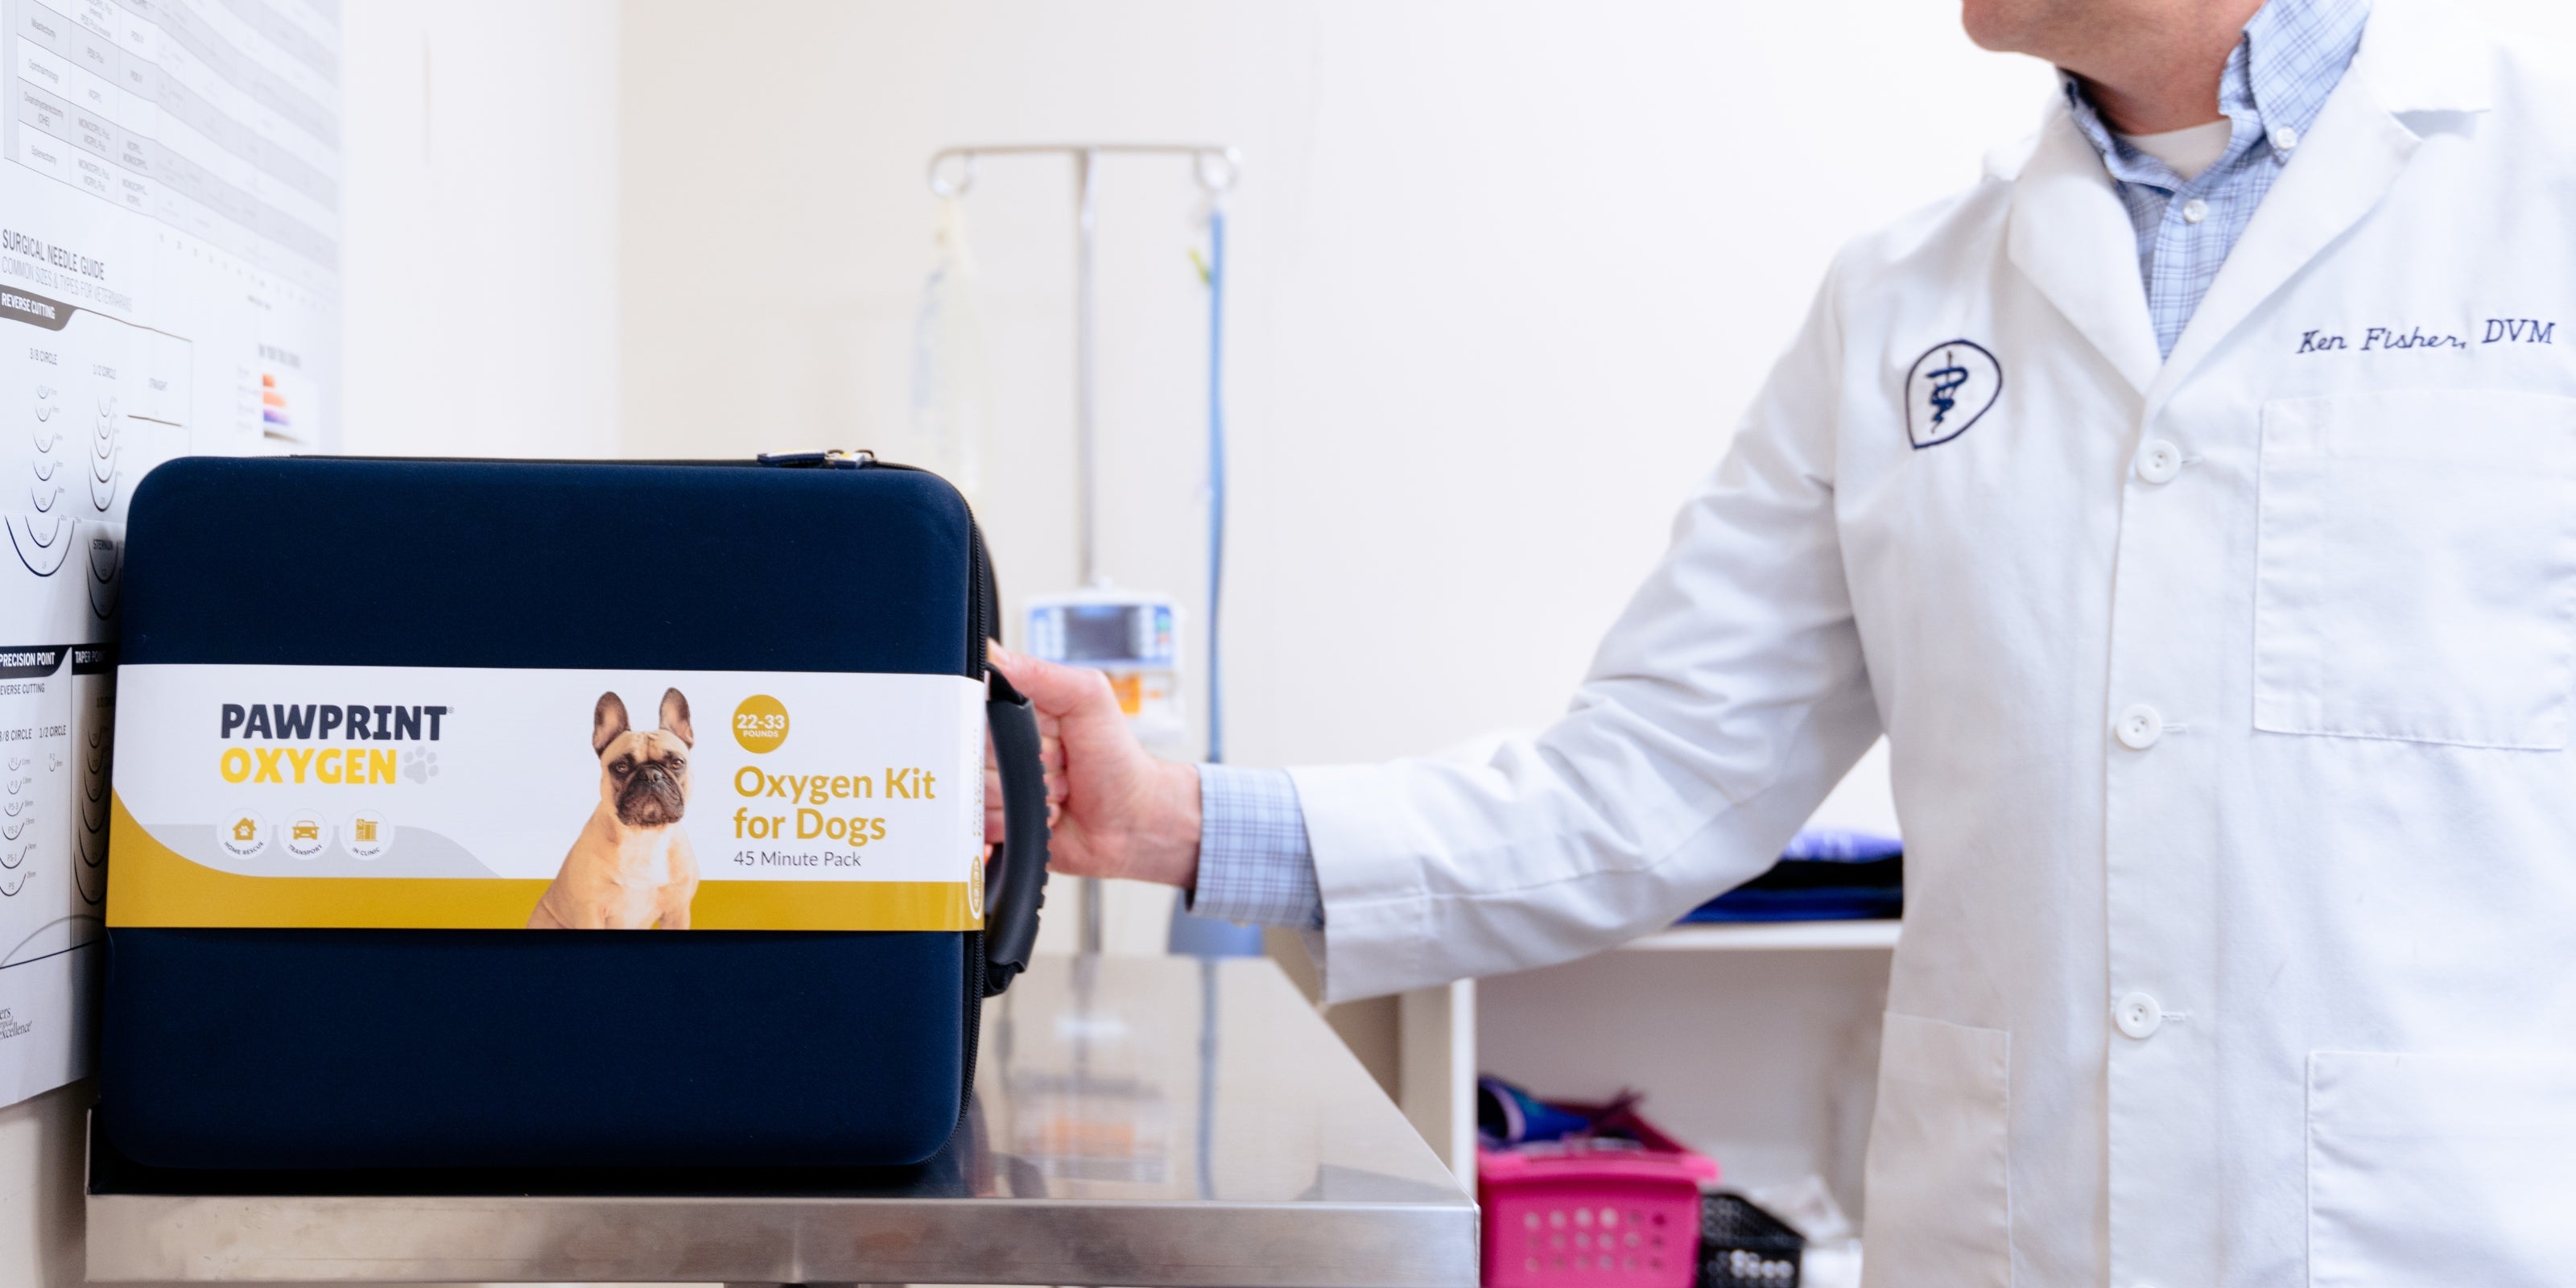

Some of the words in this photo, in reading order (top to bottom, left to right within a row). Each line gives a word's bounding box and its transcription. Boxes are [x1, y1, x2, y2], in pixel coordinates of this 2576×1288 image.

[2, 228, 45, 262] SURGICAL
[47, 244, 78, 273] NEEDLE
[80, 255, 105, 282] GUIDE
[2, 256, 35, 282] COMMON
[35, 266, 52, 287] SIZES
[60, 275, 79, 295] TYPES
[80, 280, 93, 299] FOR
[2, 292, 31, 312] REVERSE
[31, 300, 56, 320] CUTTING
[2296, 330, 2347, 354] Ken
[2360, 326, 2467, 351] Fisher,
[2481, 319, 2556, 345] DVM
[30, 347, 39, 361] 3/8
[39, 350, 58, 365] CIRCLE
[102, 365, 117, 380] CIRCLE
[0, 652, 35, 667] PRECISION
[37, 651, 56, 666] POINT
[75, 650, 91, 663] TAPER
[23, 683, 45, 694] CUTTING
[737, 714, 786, 729] 22-33
[10, 729, 32, 741] CIRCLE
[39, 727, 49, 738] 1/2
[50, 725, 66, 737] CIRCLE
[743, 730, 779, 738] POUNDS
[220, 747, 397, 784] OXYGEN
[733, 766, 873, 805] Oxygen
[885, 767, 936, 799] Kit
[733, 807, 786, 840] for
[796, 808, 886, 847] Dogs
[224, 841, 242, 856] HOME
[242, 841, 264, 855] RESCUE
[287, 844, 323, 856] TRANSPORT
[360, 847, 381, 856] CLINIC
[733, 851, 754, 866] 45
[761, 851, 819, 866] Minute
[824, 852, 861, 867] Pack
